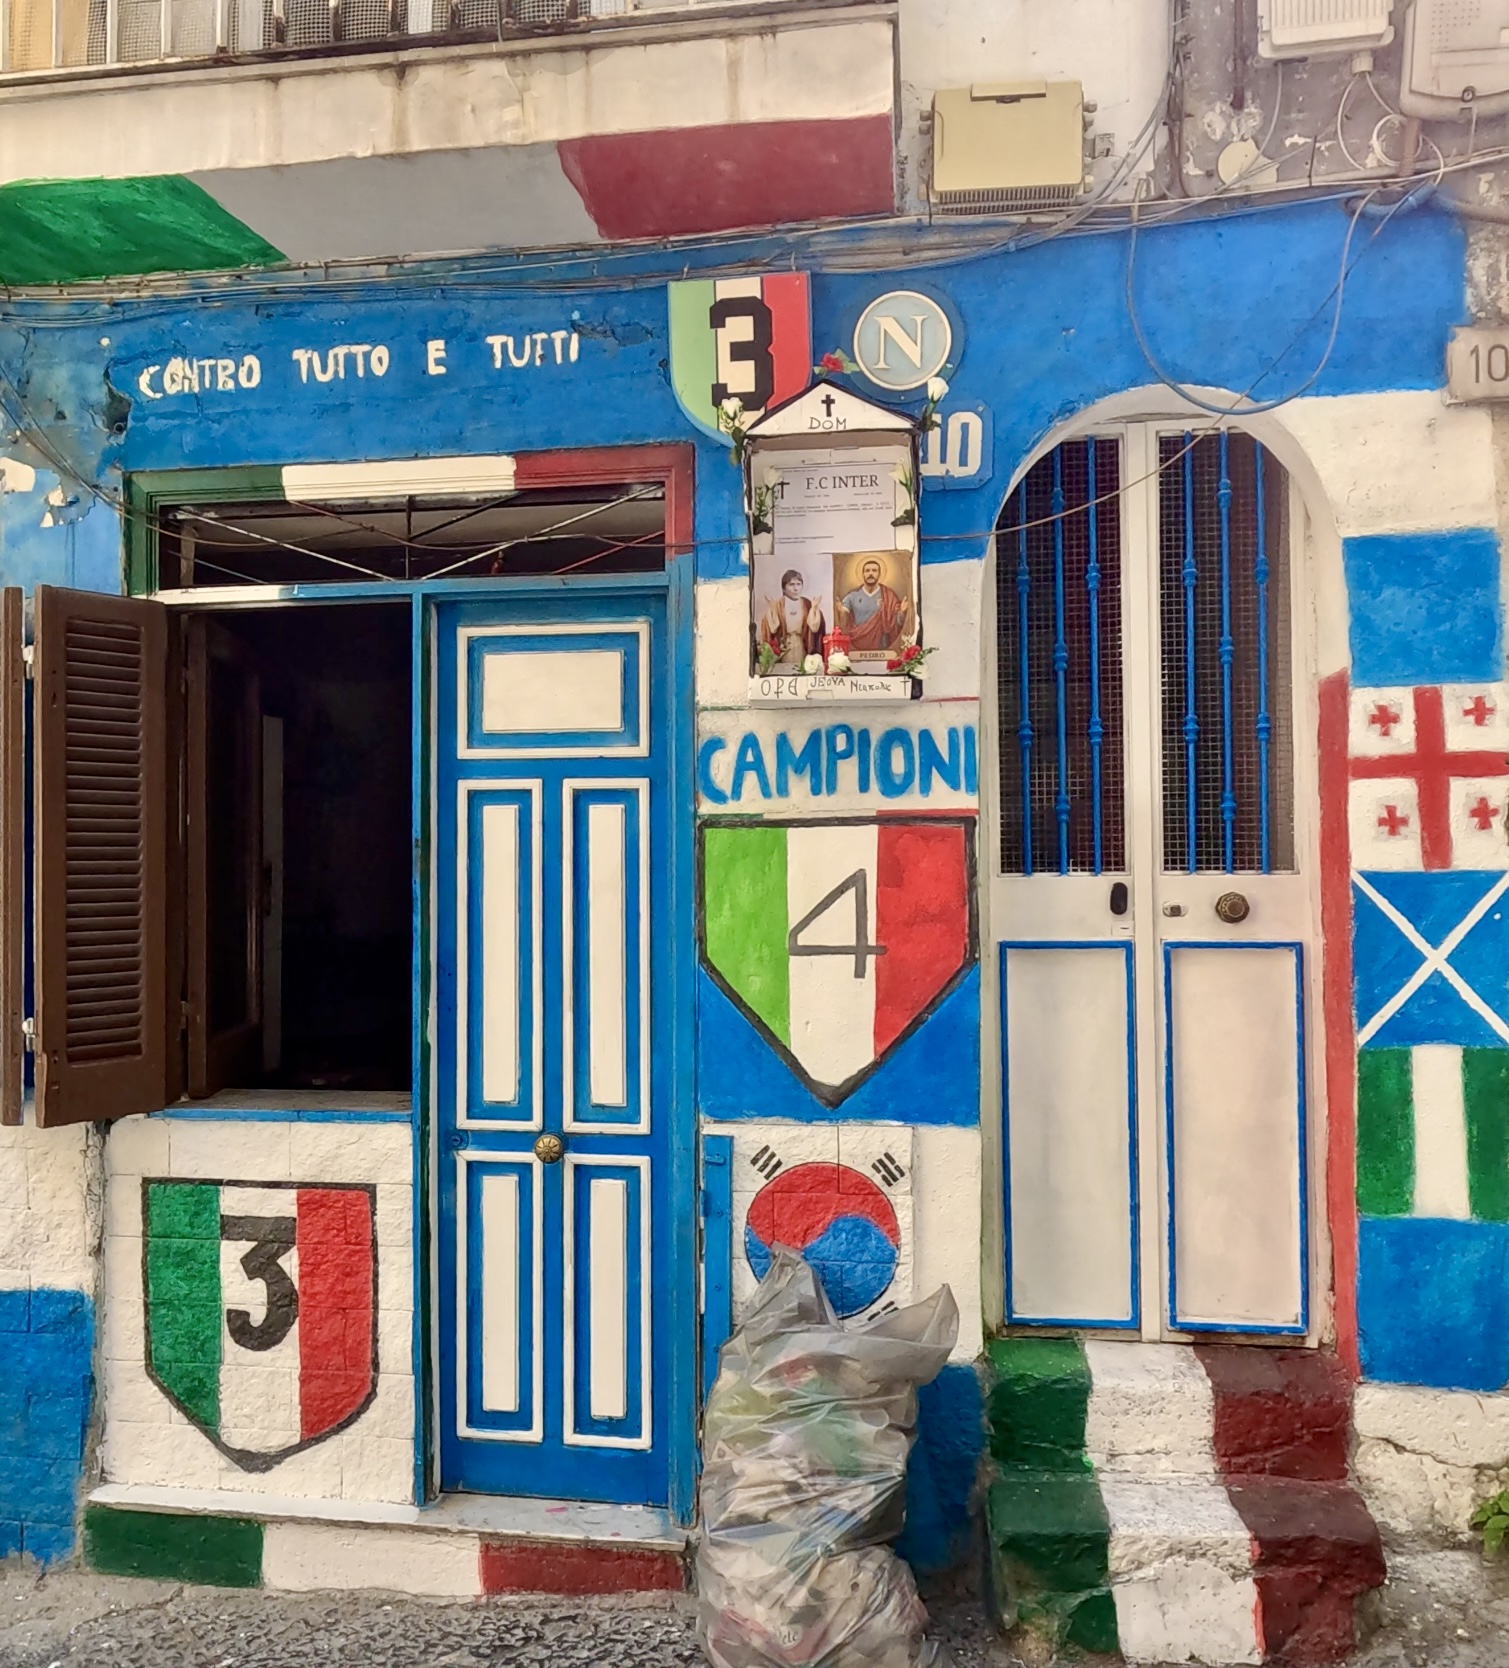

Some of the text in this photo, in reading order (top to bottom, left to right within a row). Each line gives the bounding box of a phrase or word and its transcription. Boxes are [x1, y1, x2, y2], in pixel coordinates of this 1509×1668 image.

[138, 330, 579, 398] CONTRO TUTTO E TUTTI
[709, 296, 774, 412] 3
[872, 314, 928, 370] N
[1470, 344, 1509, 383] 10
[920, 411, 982, 478] 10
[805, 474, 879, 490] F.C INTER
[698, 723, 979, 805] CAMPIONI
[788, 867, 888, 979] 4
[220, 1213, 299, 1352] 3
